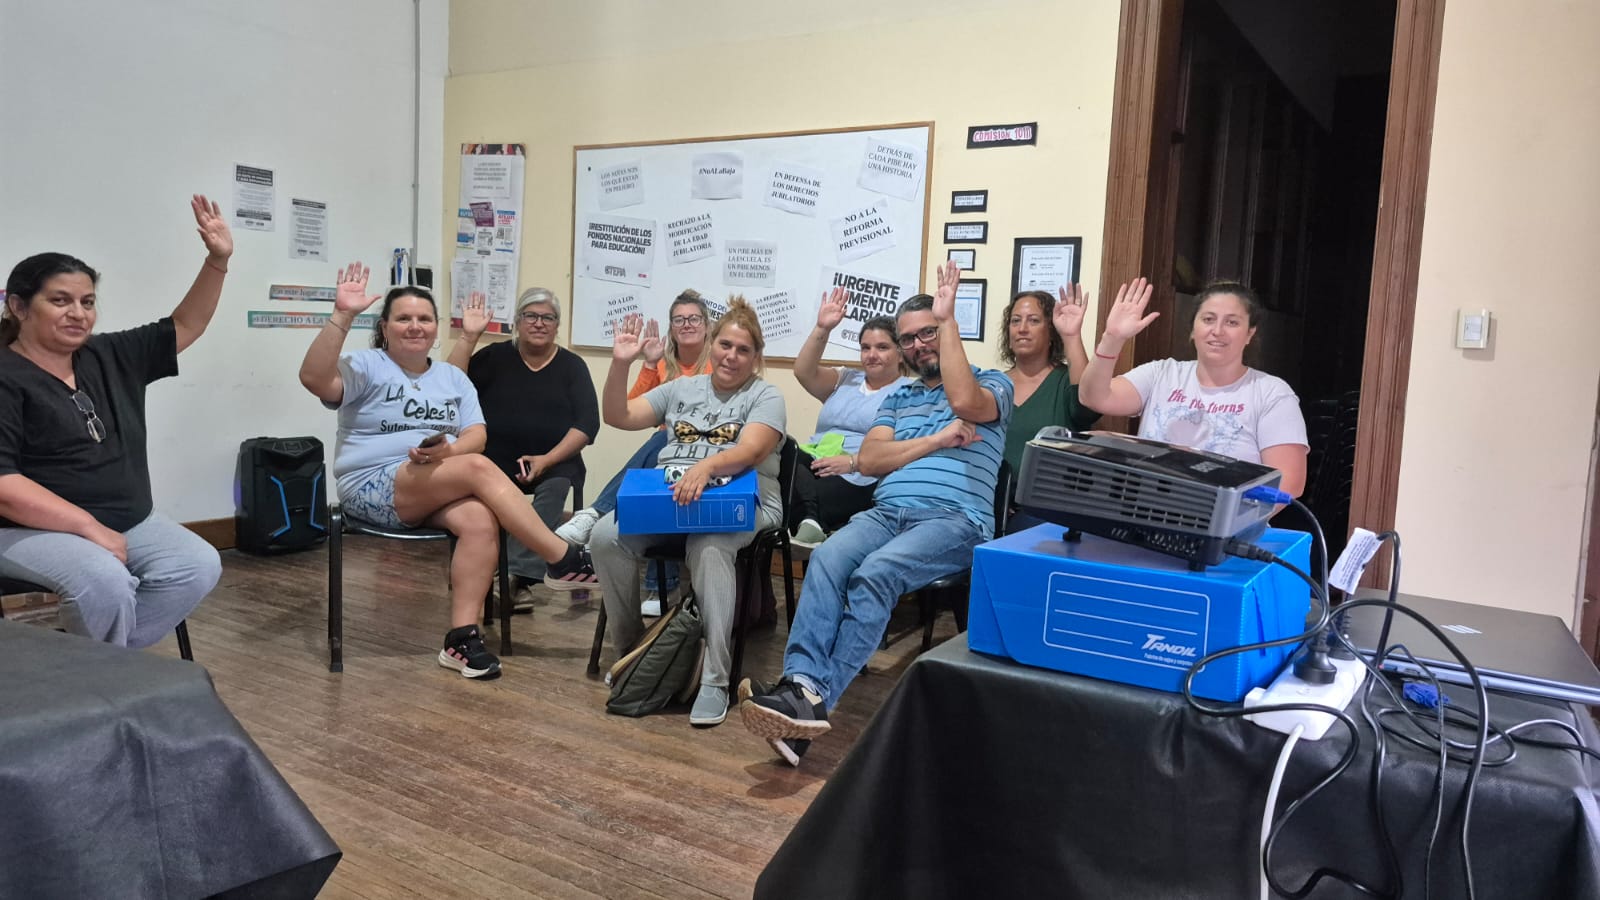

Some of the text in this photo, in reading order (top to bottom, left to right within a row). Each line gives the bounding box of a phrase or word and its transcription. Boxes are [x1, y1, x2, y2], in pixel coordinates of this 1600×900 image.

[868, 152, 918, 170] CADA PIBE HAY
[903, 152, 913, 160] DE
[867, 161, 913, 179] UNA HISTORIA
[774, 171, 821, 188] EN DEFENSA DE
[772, 180, 819, 198] LOS DERECHOS
[771, 191, 816, 207] JUBILATORIOS
[668, 216, 696, 229] RECHAZO
[702, 212, 711, 220] LA
[844, 214, 857, 225] NO
[865, 207, 877, 217] LA
[631, 227, 639, 236] DE
[640, 229, 652, 238] LOS
[843, 217, 884, 237] REFORMA
[587, 231, 652, 247] FONDOS NACIONALES
[591, 240, 607, 250] PARA
[683, 237, 691, 245] LA
[692, 232, 708, 242] EDAD
[839, 225, 893, 251] PREVISIONAL
[673, 242, 712, 256] JUBILATORIA
[745, 271, 767, 279] DELITO
[763, 291, 788, 301] REFORMA
[606, 304, 638, 317] AUMENTOS
[756, 299, 788, 311] PREVISIONAL
[261, 314, 304, 324] DERECHO
[312, 316, 324, 325] LA
[385, 384, 405, 402] LA
